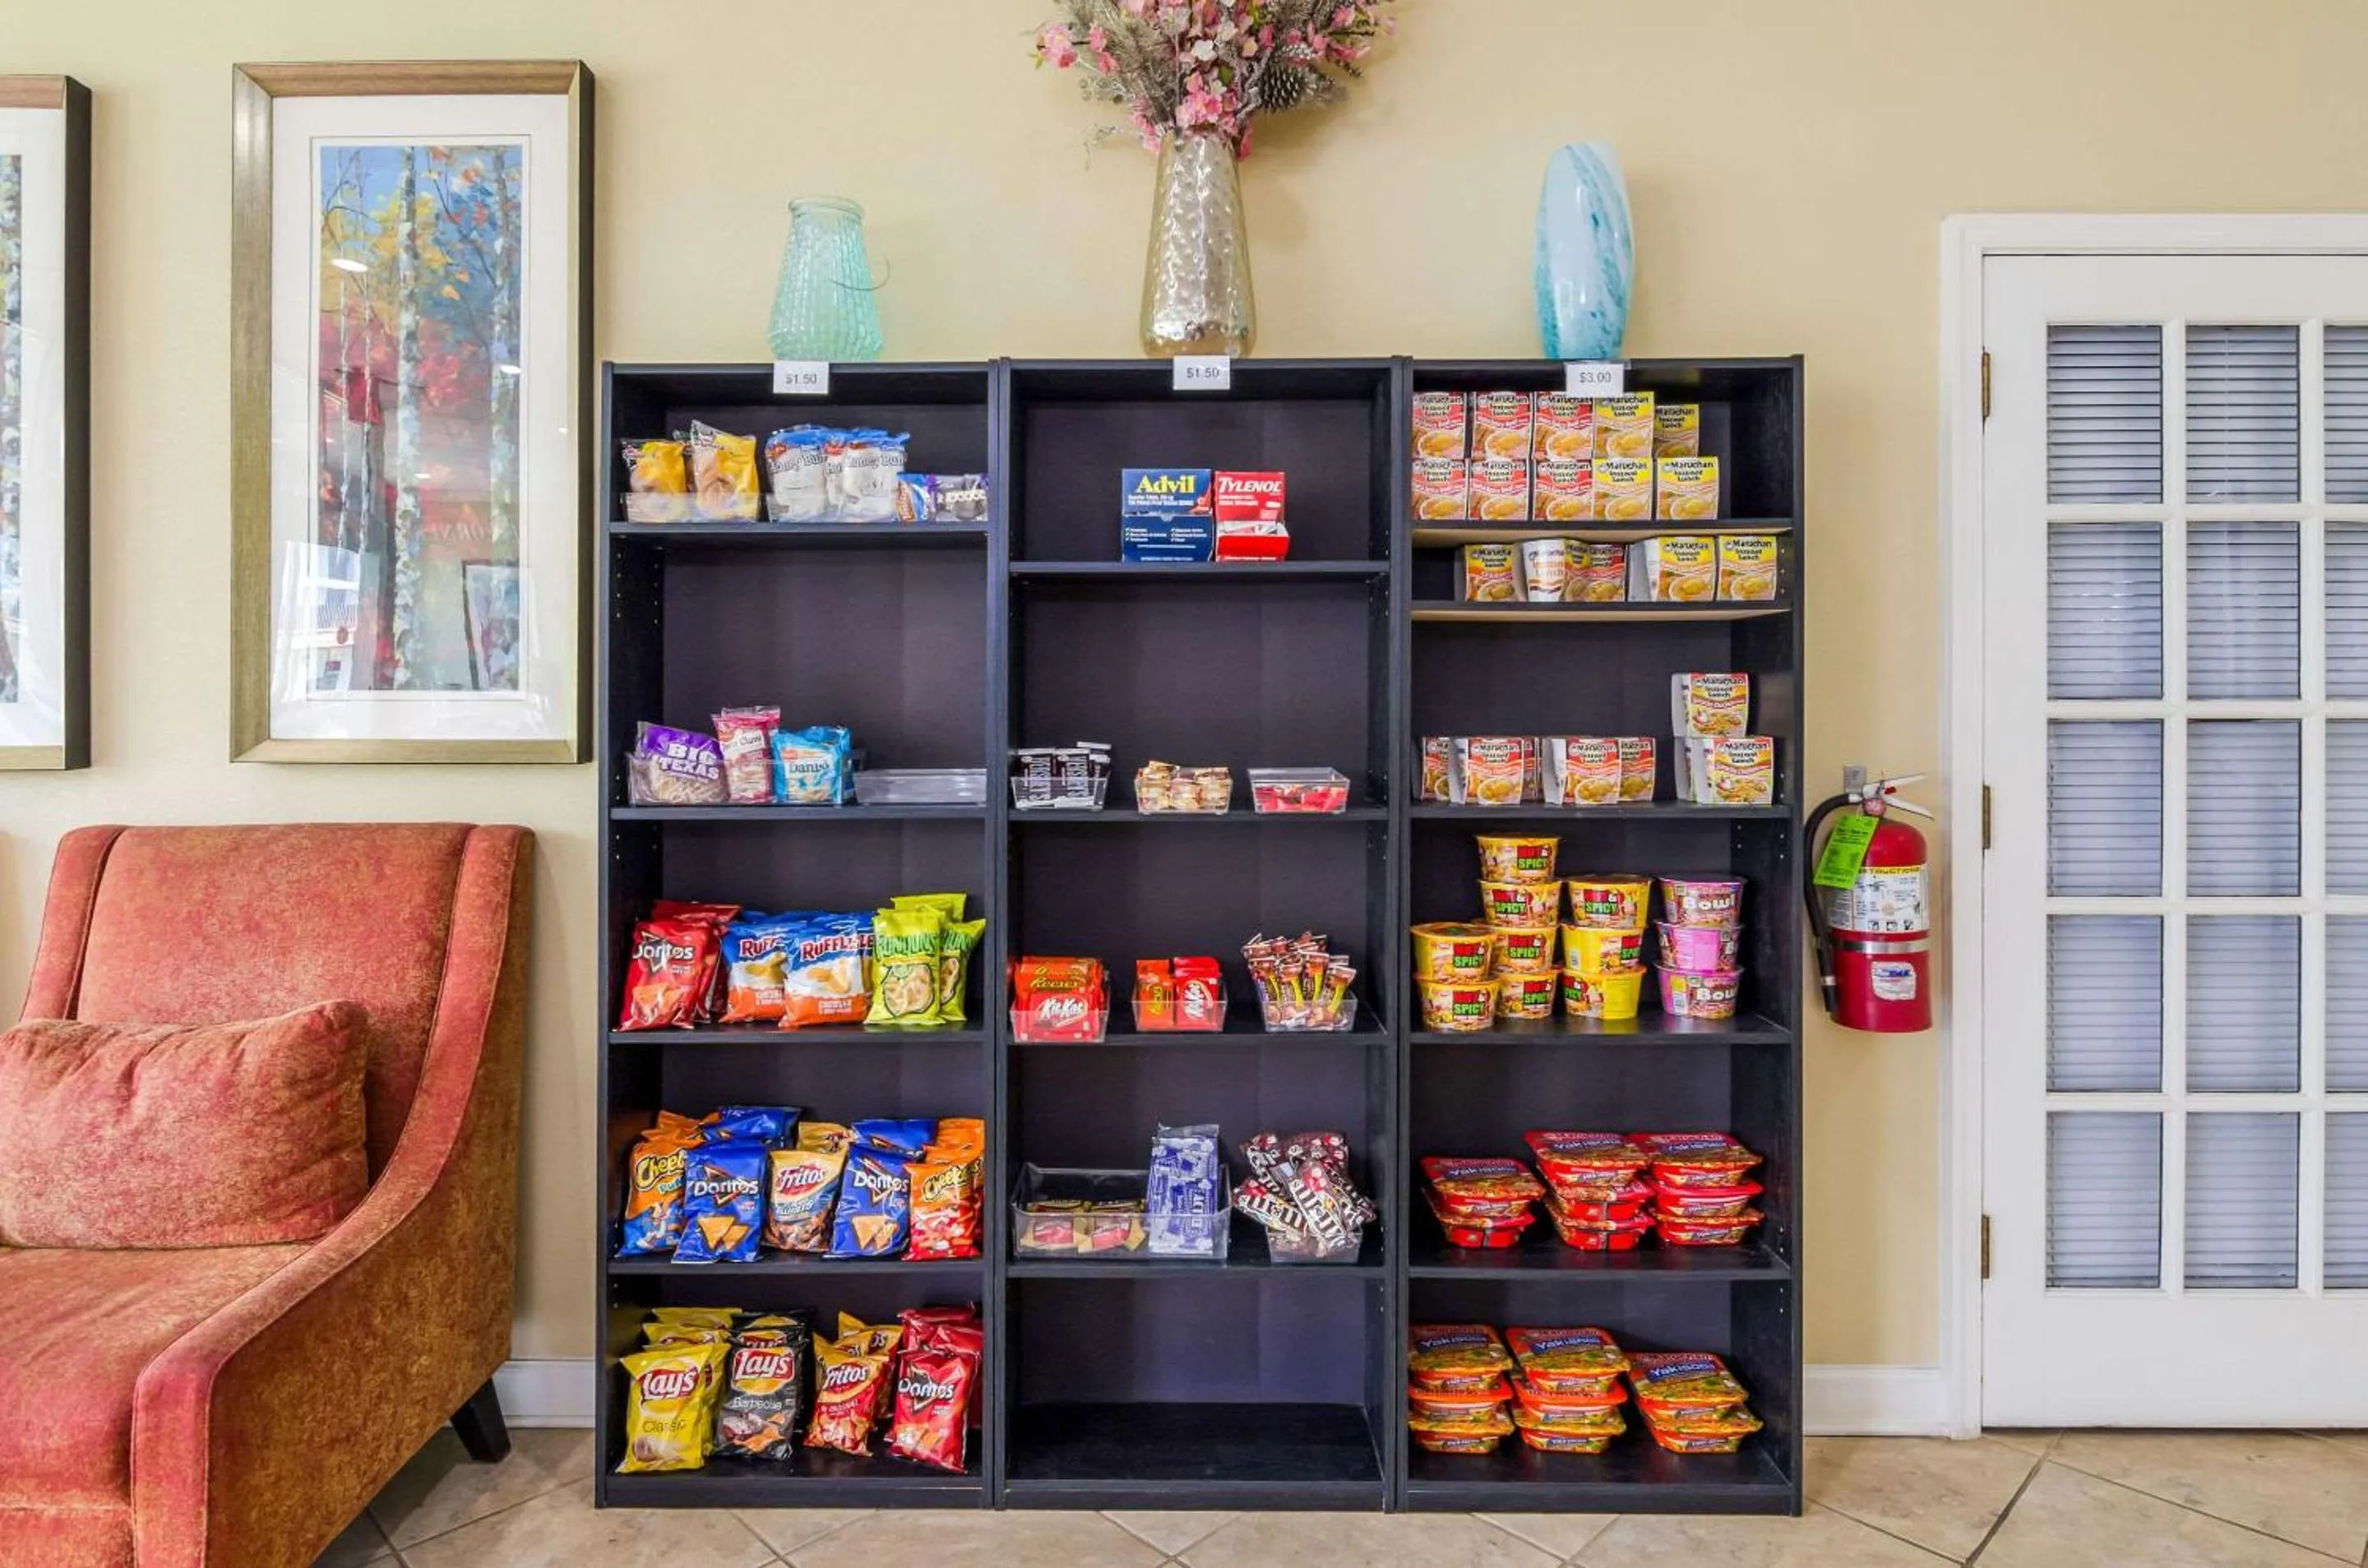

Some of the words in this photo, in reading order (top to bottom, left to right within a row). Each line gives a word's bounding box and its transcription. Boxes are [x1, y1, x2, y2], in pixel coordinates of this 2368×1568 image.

[785, 372, 817, 385] $1.50
[1186, 367, 1220, 379] $1.50
[1579, 372, 1612, 383] $3.00
[1135, 474, 1196, 493] Advil
[1219, 477, 1283, 493] TYLENOL
[667, 742, 718, 766] BIG
[659, 756, 720, 780] TEXAS
[1682, 894, 1735, 910] Bowl
[741, 936, 783, 957] RUFF
[1696, 988, 1737, 1001] Bow
[636, 1149, 687, 1190] Cheet
[775, 1164, 826, 1192] Fritos
[693, 1177, 759, 1196] Doritos
[853, 1170, 909, 1192] Doritos
[822, 1365, 869, 1390] Fritos
[1649, 1362, 1716, 1377] Yakisoba
[898, 1377, 955, 1399] Doritos
